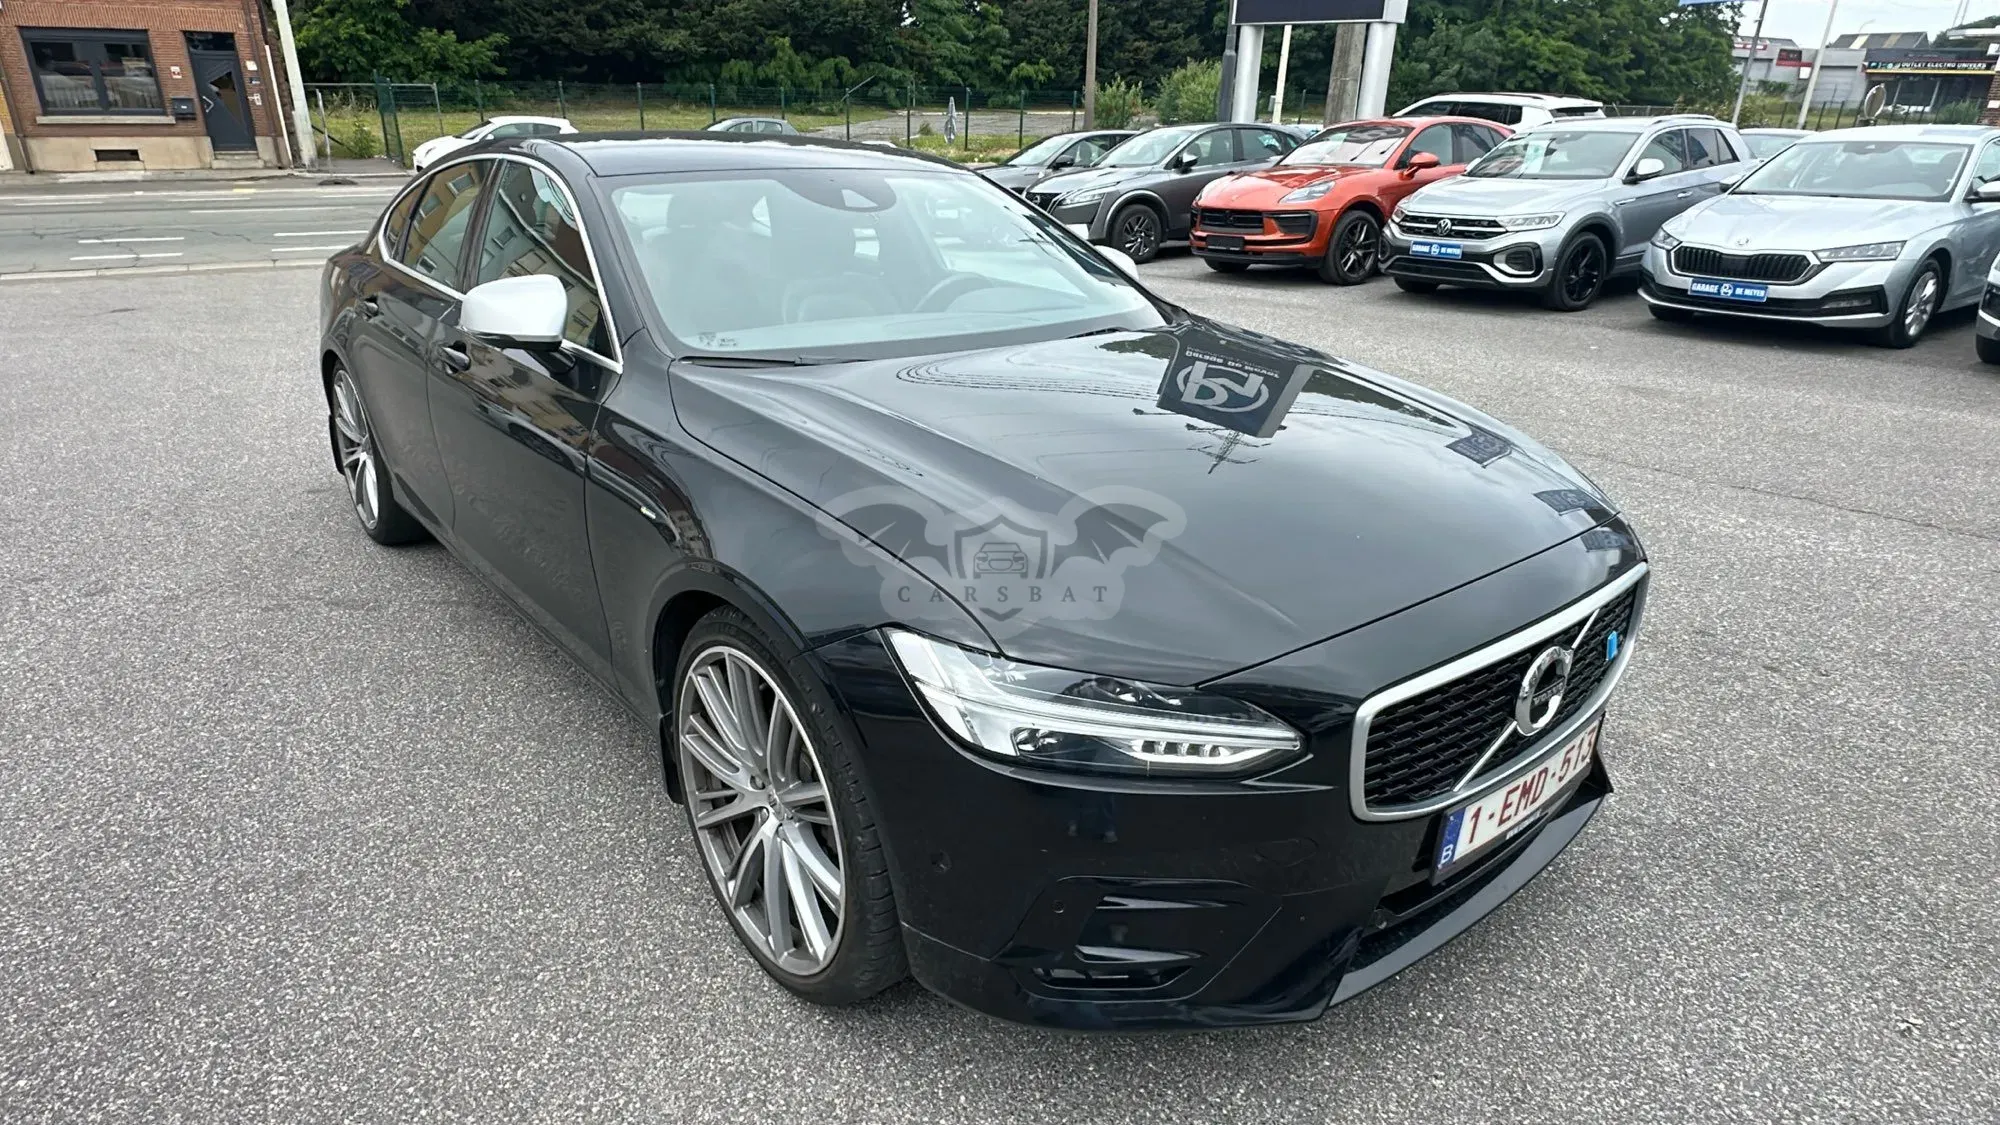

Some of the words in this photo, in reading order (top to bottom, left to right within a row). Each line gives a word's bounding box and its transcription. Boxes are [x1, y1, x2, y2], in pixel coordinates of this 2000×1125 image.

[1691, 282, 1720, 293] GARAGE
[1734, 287, 1744, 295] DE
[1743, 288, 1766, 297] MEYER
[1468, 726, 1597, 845] 1-EMD-513
[1439, 843, 1455, 866] B
